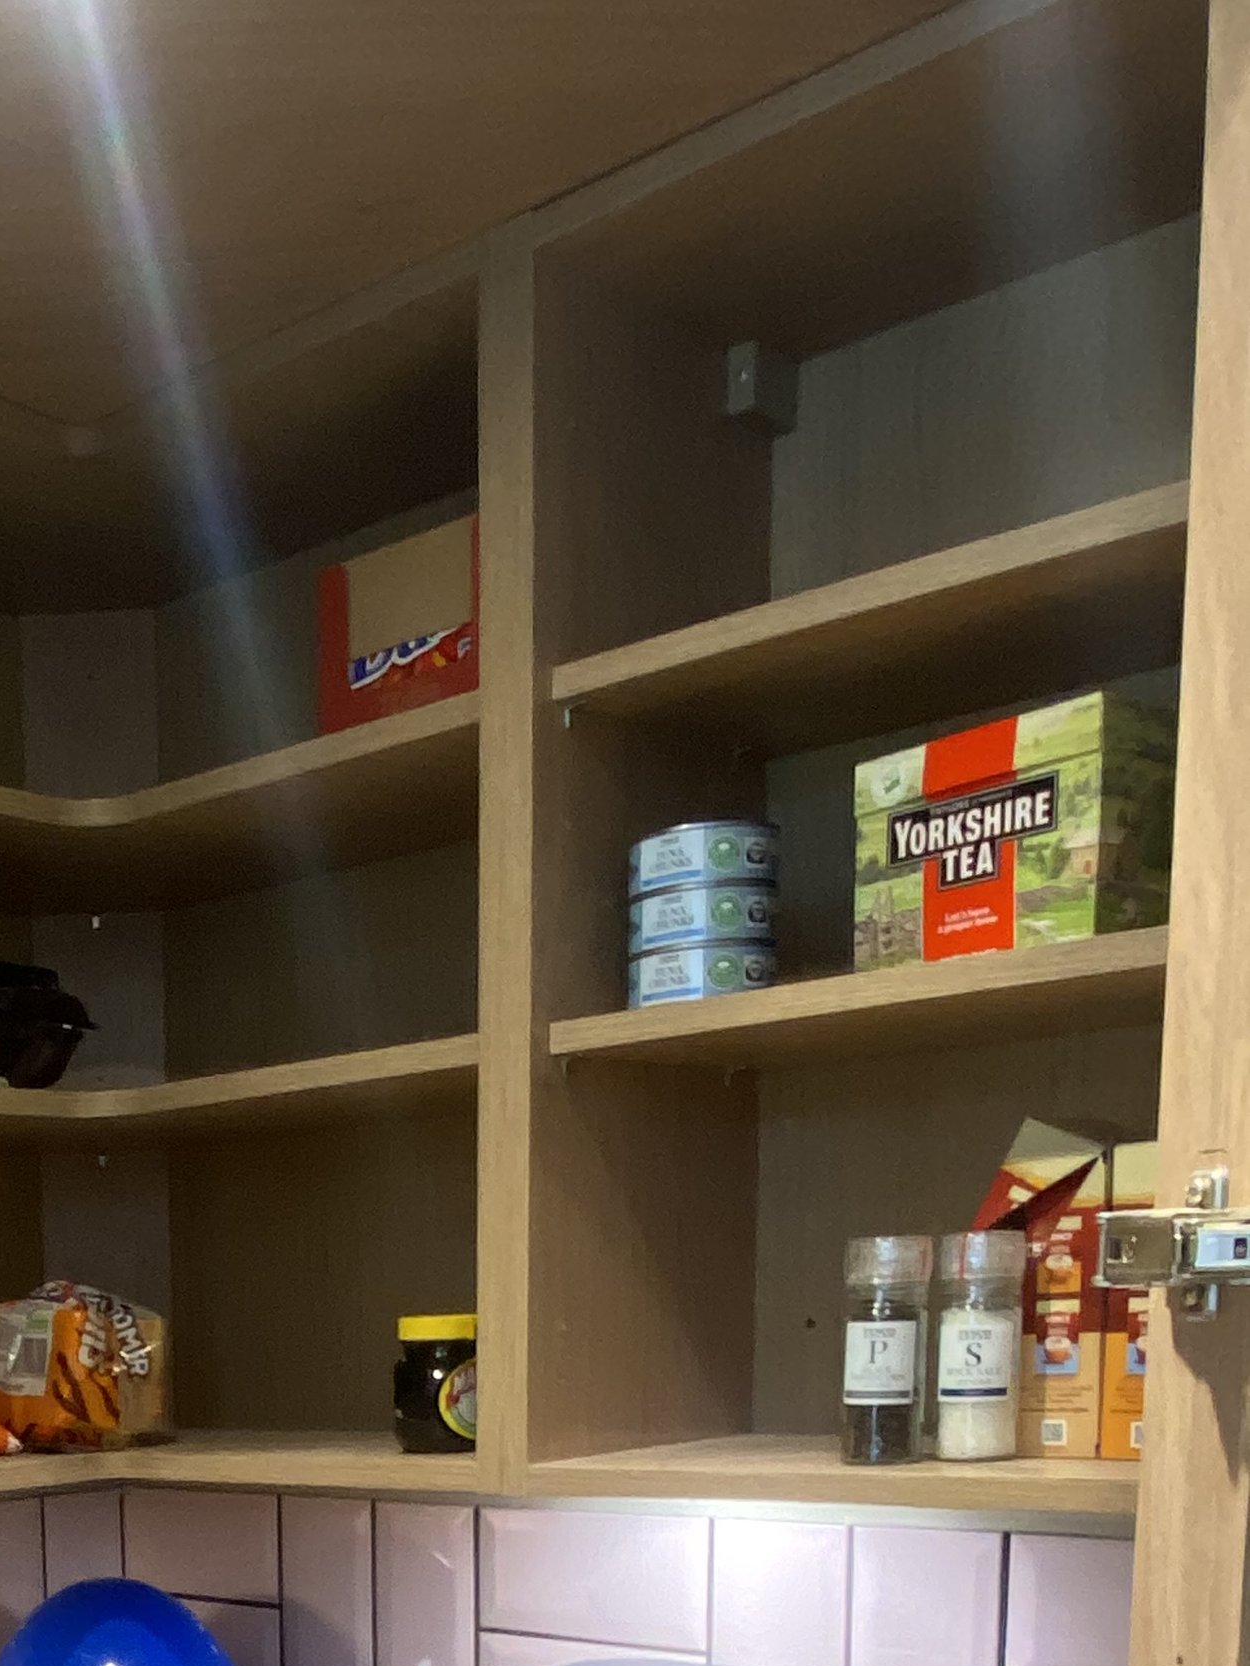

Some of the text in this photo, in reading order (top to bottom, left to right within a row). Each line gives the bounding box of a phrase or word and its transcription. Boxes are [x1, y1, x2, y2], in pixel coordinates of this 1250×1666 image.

[894, 790, 1051, 859] YORKSHIRE
[942, 842, 994, 882] TEA
[869, 1339, 889, 1365] P
[964, 1343, 983, 1367] S
